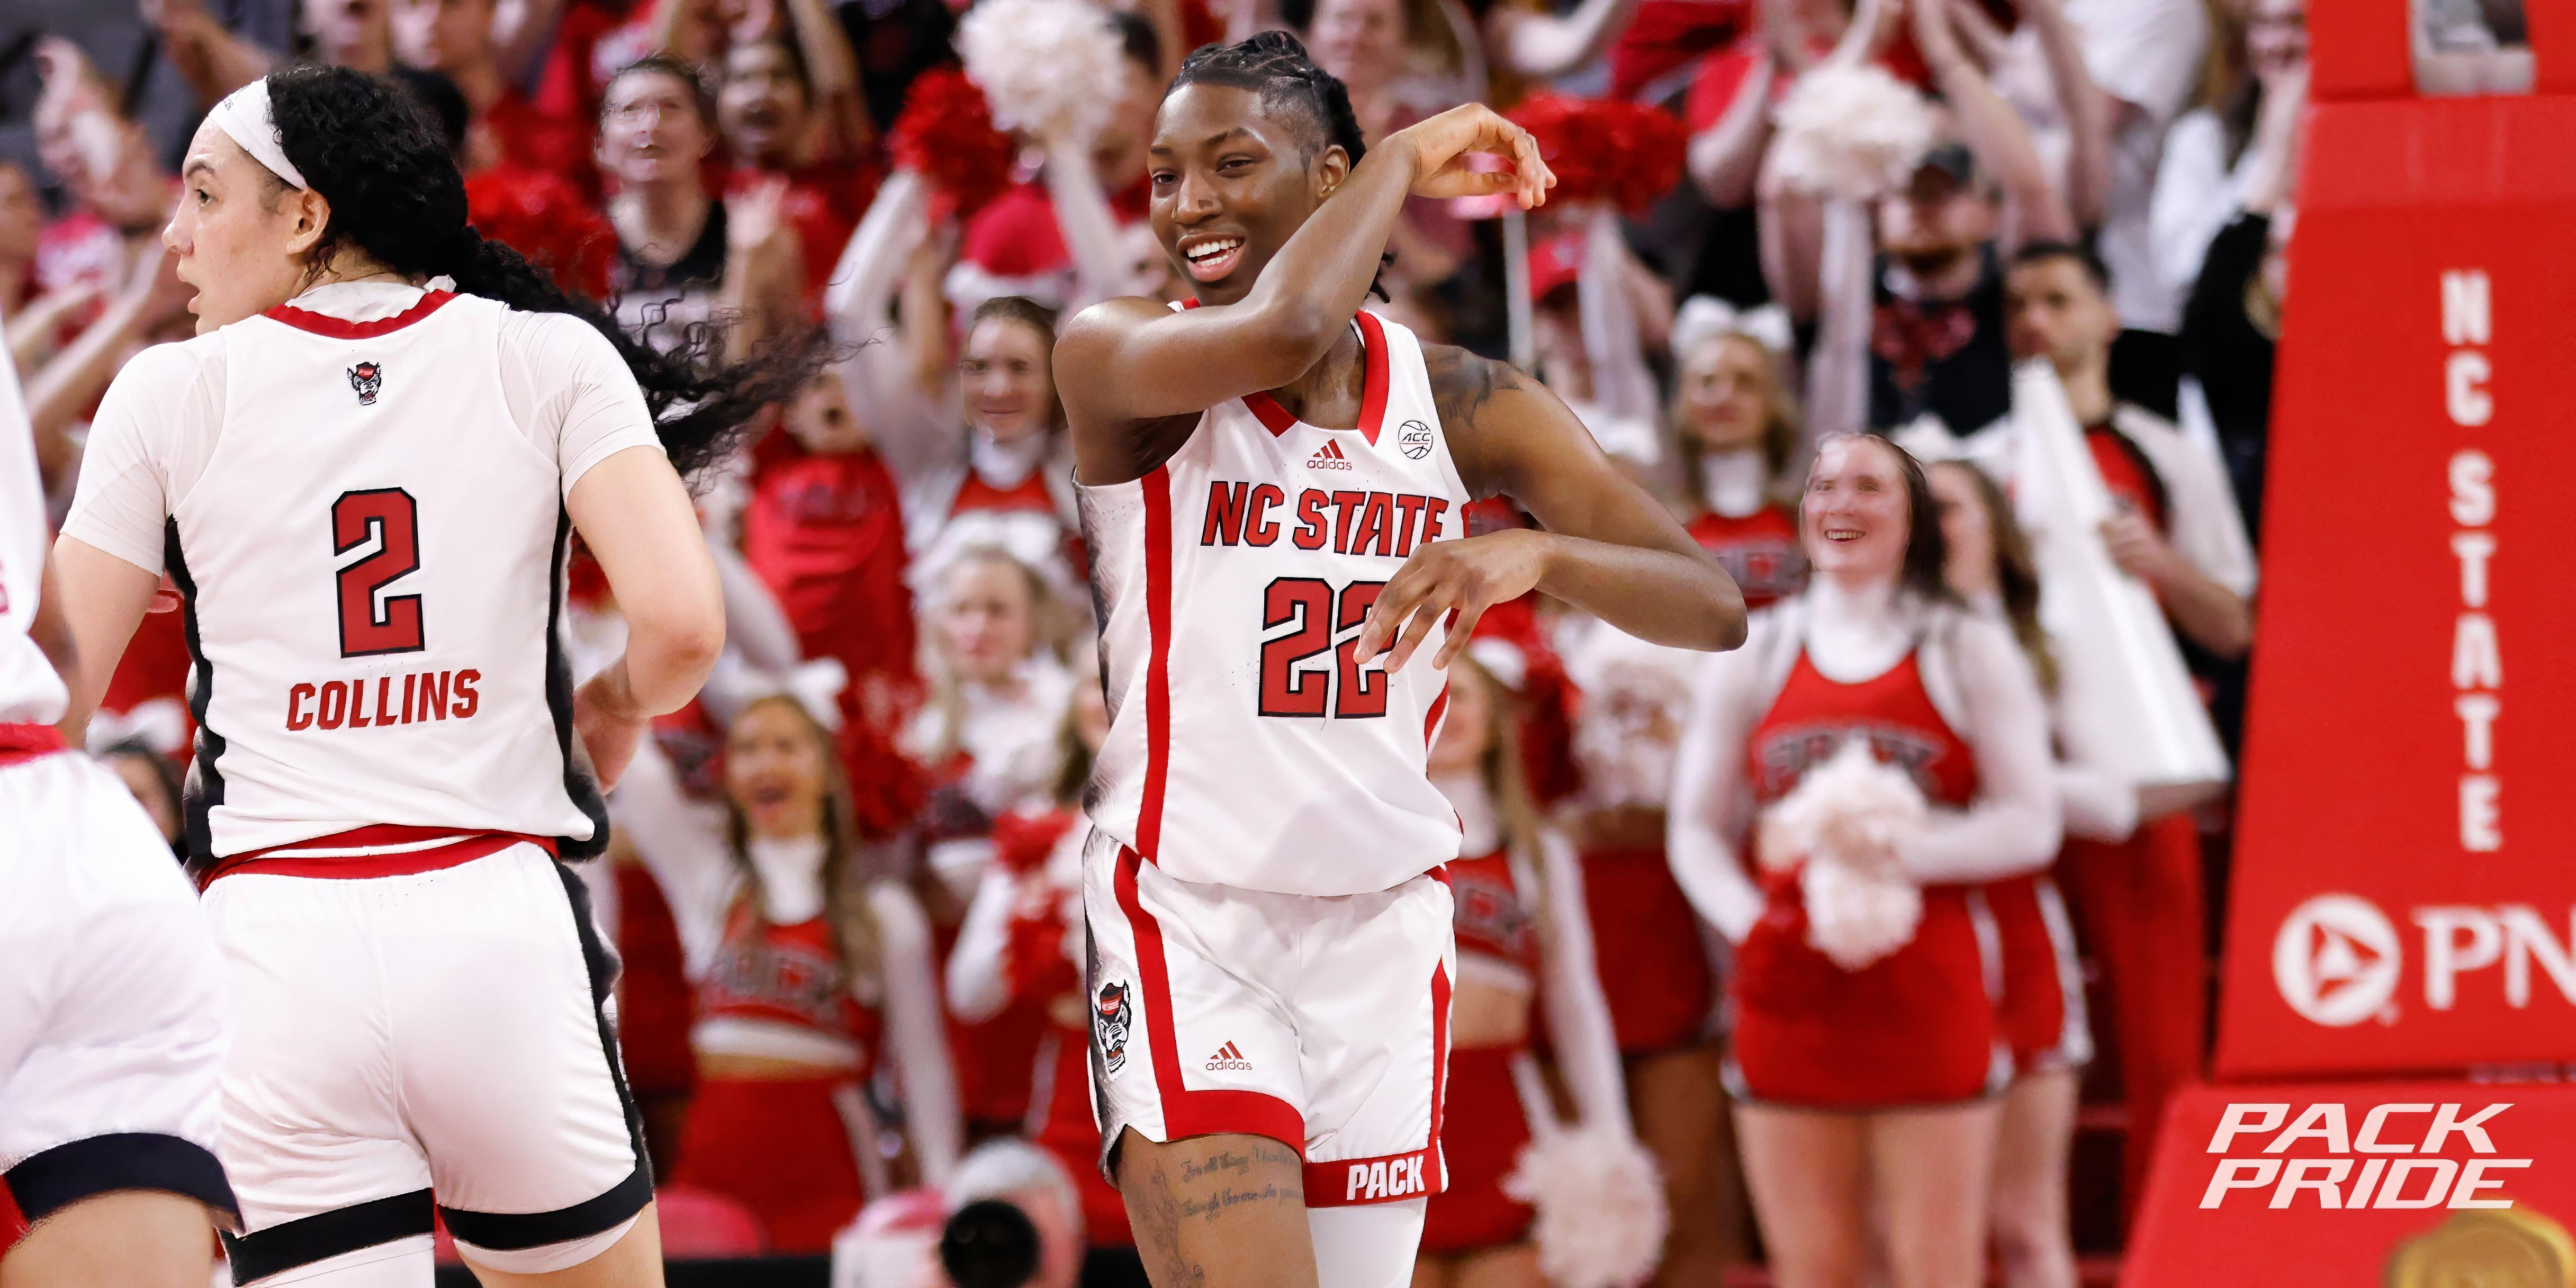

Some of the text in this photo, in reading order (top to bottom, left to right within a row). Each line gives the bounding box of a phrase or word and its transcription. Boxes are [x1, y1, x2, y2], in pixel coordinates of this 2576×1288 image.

[1307, 457, 1353, 471] adidas
[1402, 433, 1431, 442] ACC
[1200, 481, 1285, 547] NC
[331, 486, 426, 659] 2
[2440, 268, 2503, 853] NC STATE
[1258, 576, 1401, 719] 22
[286, 668, 482, 732] COLLINS
[1205, 1059, 1253, 1070] adidas
[1346, 1154, 1425, 1201] PACK
